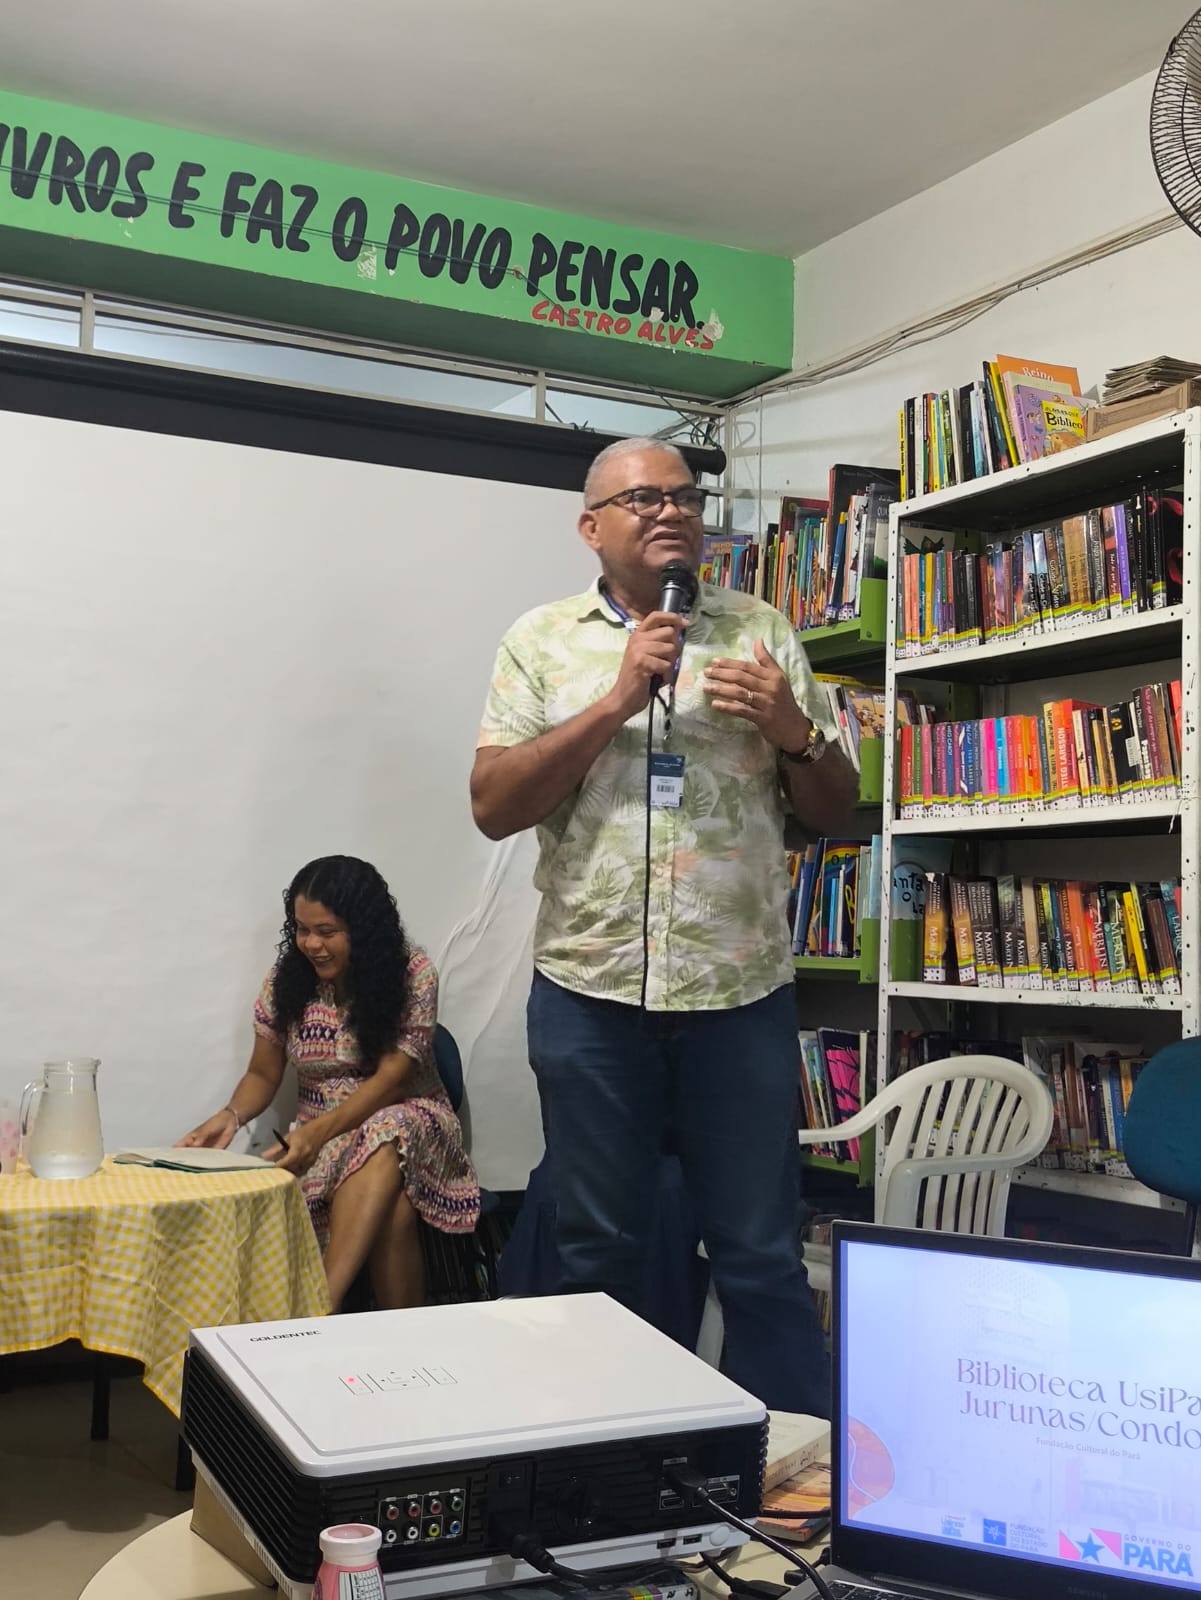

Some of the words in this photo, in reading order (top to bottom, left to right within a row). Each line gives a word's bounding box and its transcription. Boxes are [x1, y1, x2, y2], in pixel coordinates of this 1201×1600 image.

[168, 161, 206, 228] E
[220, 171, 319, 252] FAZ
[332, 197, 367, 262] O
[384, 203, 512, 289] POVO
[532, 300, 631, 335] CASTRO
[637, 320, 714, 350] ALVES
[1093, 921, 1108, 968] MERLIN
[957, 1358, 1107, 1404] Biblioteca
